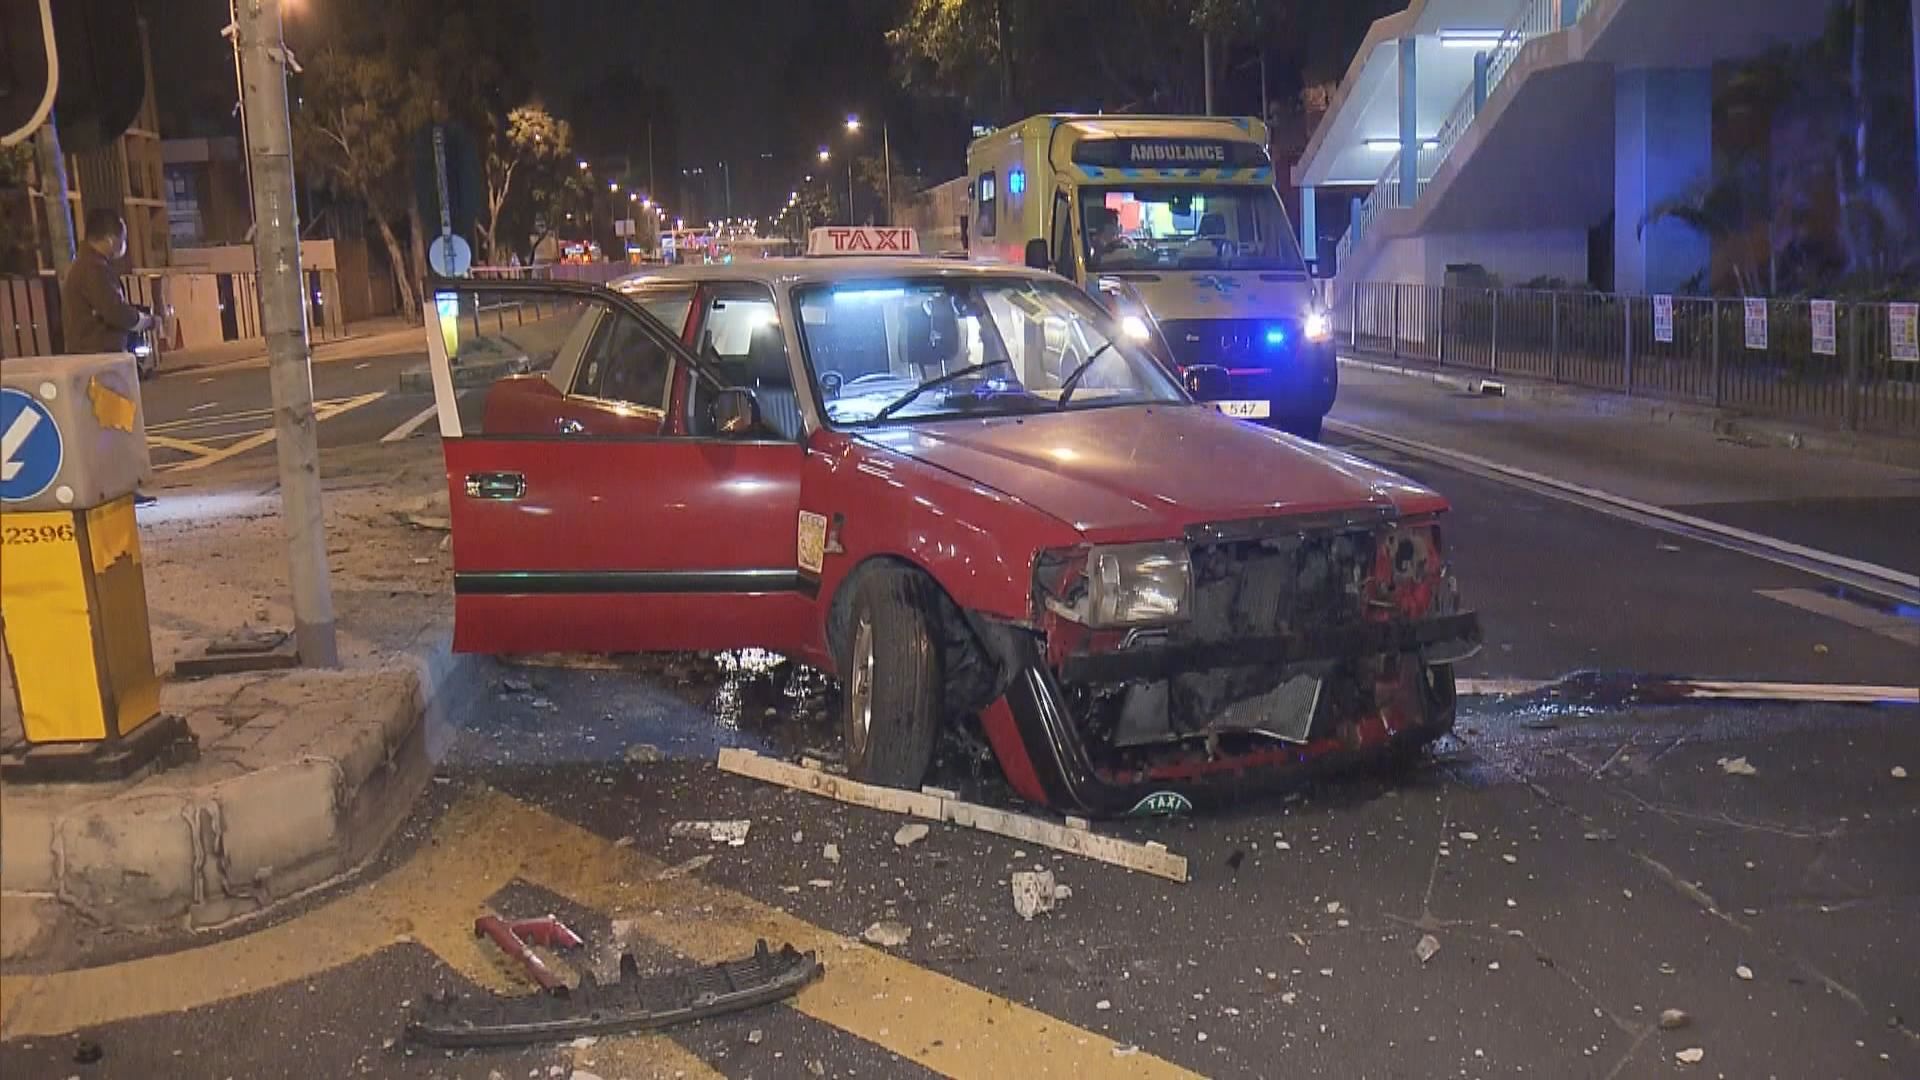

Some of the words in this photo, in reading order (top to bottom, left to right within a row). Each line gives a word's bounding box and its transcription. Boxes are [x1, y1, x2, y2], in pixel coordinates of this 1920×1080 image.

[1130, 143, 1225, 161] AMBULANCE
[828, 229, 911, 251] TAXI
[0, 524, 73, 545] 2396
[1148, 795, 1181, 809] TAXI
